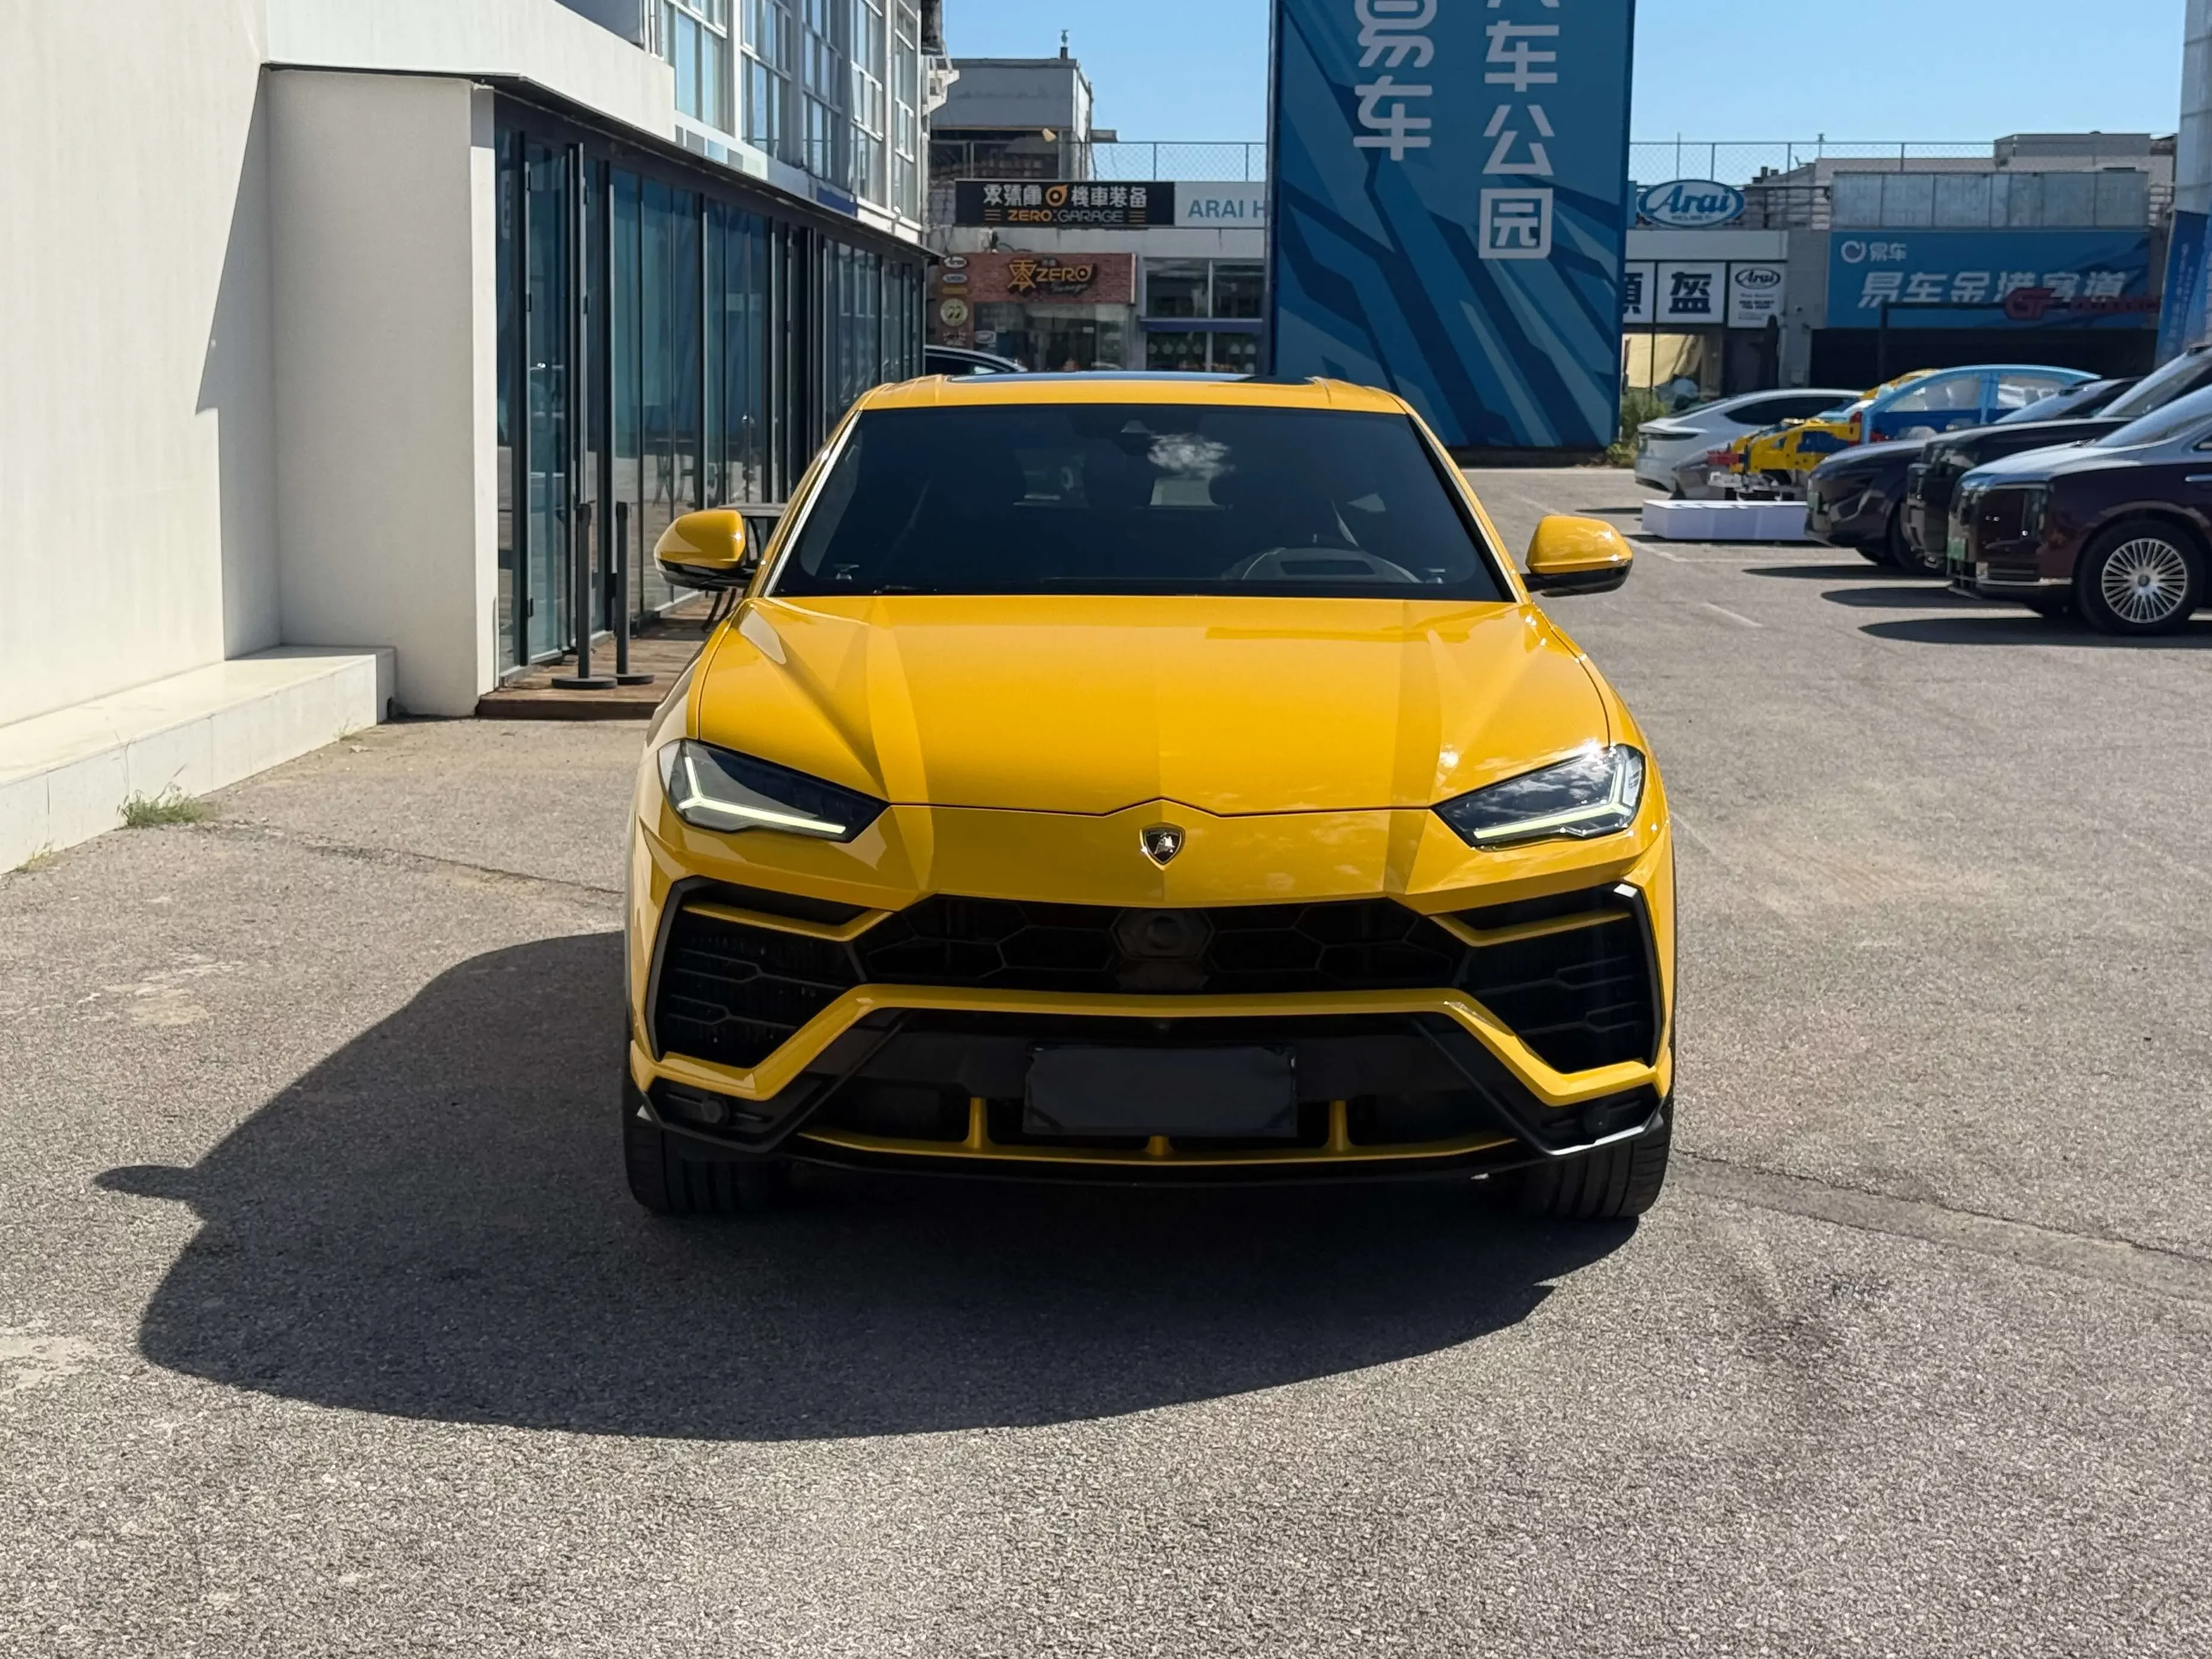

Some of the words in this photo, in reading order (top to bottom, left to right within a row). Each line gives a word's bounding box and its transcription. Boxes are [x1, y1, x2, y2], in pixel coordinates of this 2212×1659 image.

[1478, 0, 1560, 259] 车公园
[1188, 199, 1244, 218] ARAI
[1653, 185, 1731, 212] Arai
[1007, 210, 1053, 222] ZERO
[1057, 210, 1124, 222] GARAGE
[1869, 241, 1906, 262] 易车
[1035, 264, 1093, 282] ZERO
